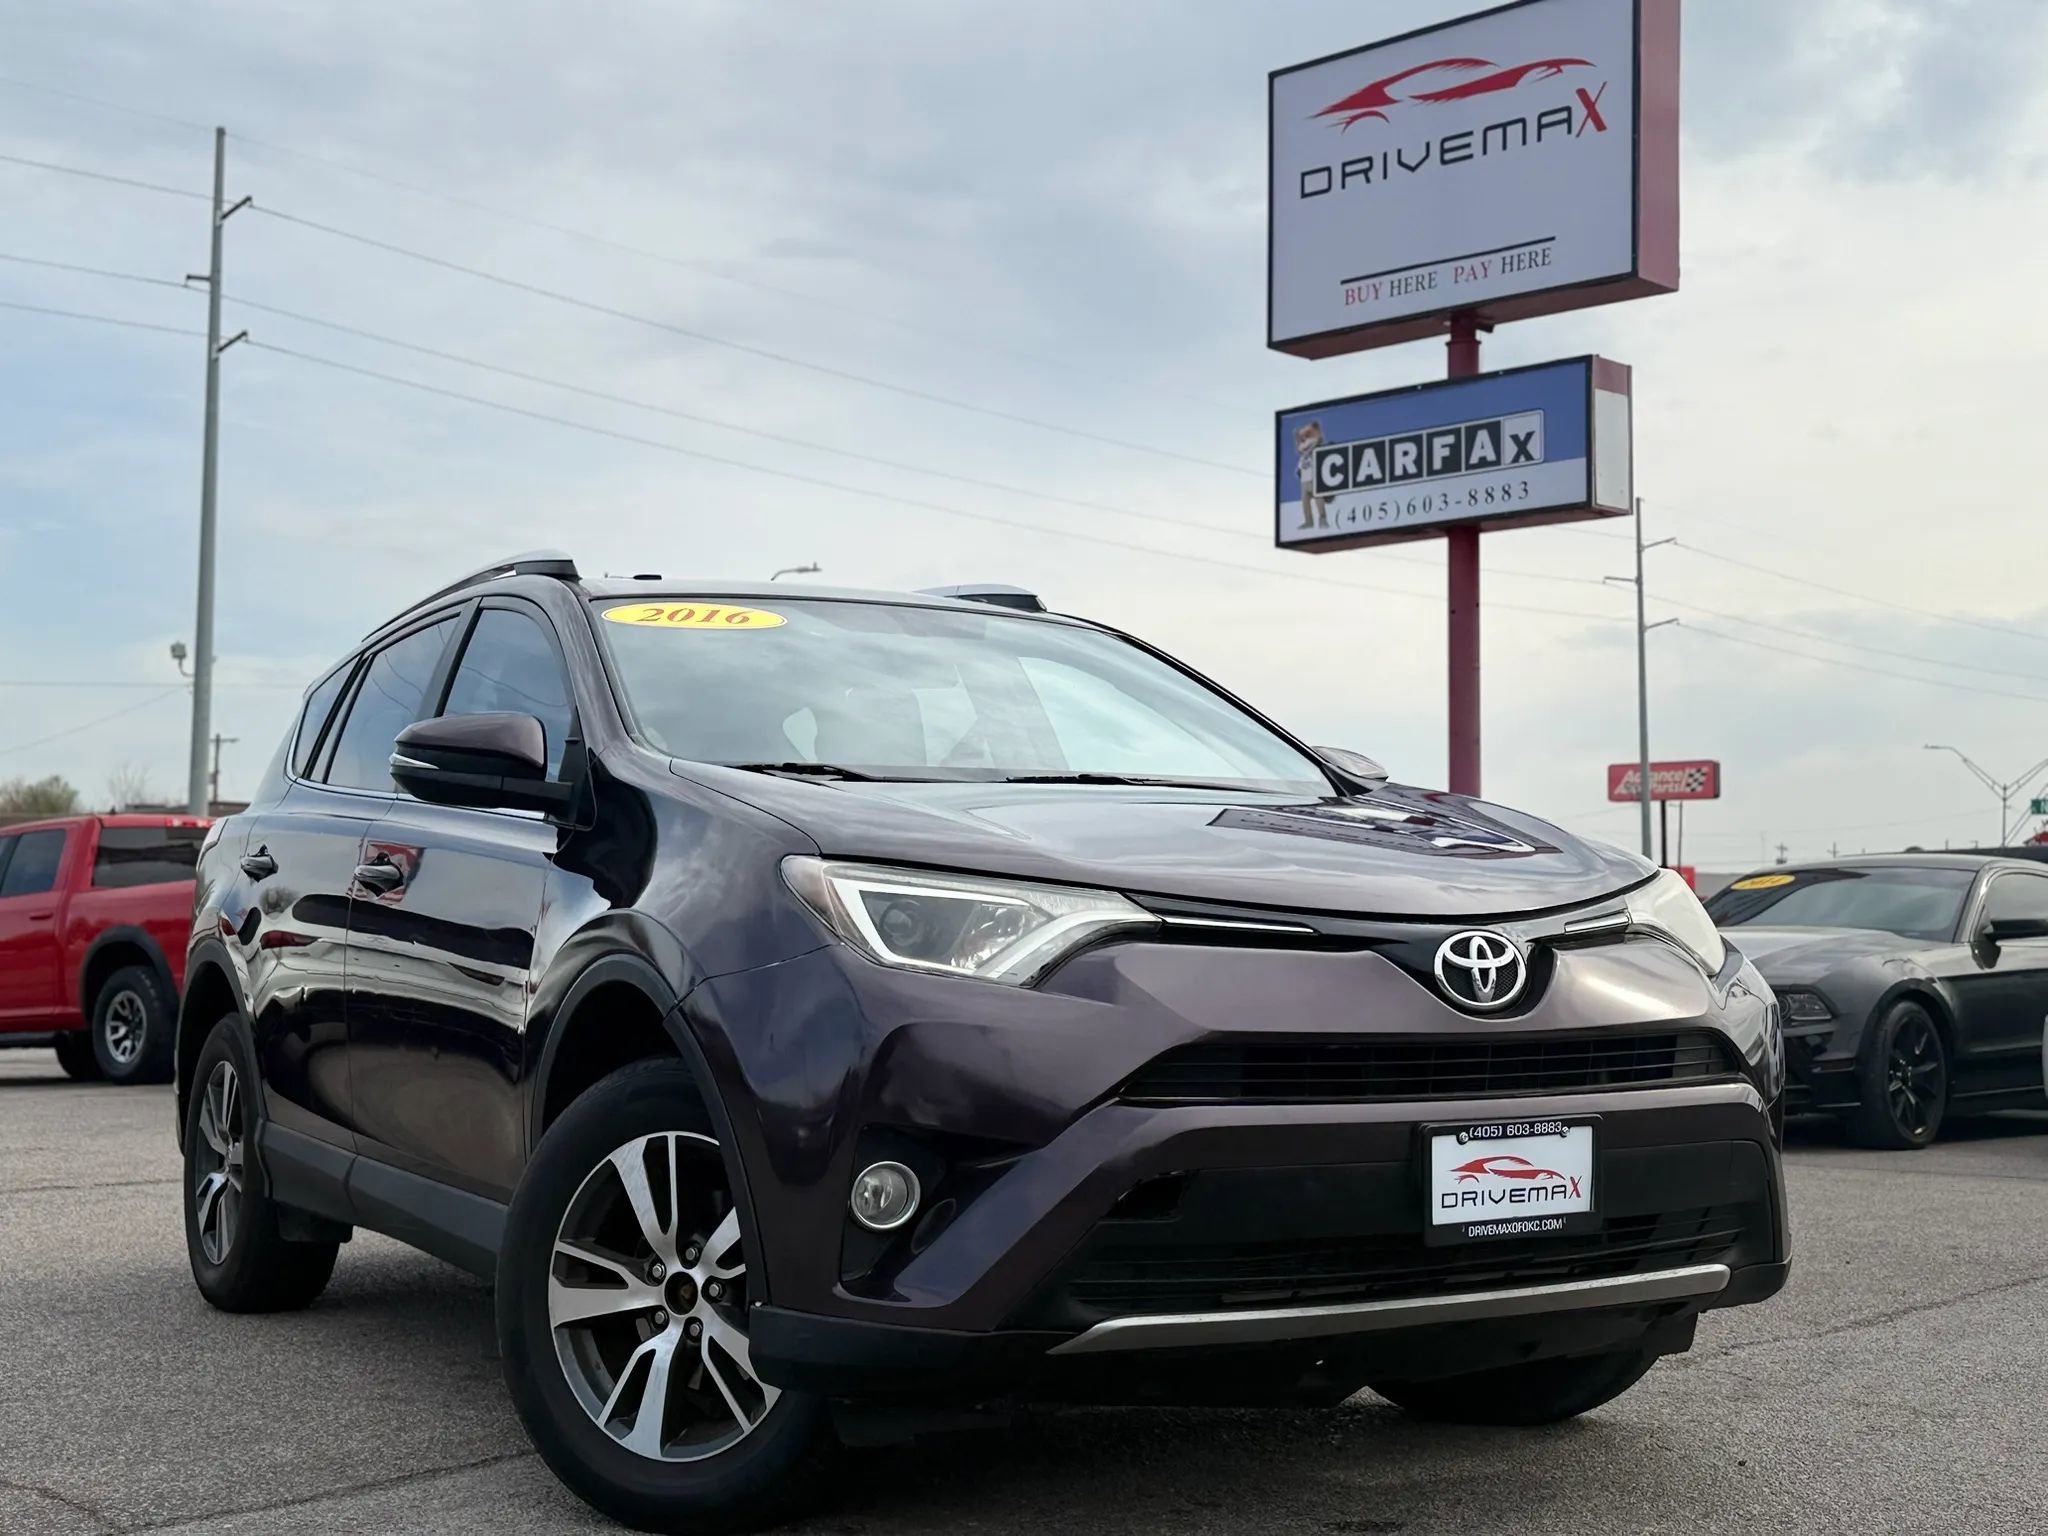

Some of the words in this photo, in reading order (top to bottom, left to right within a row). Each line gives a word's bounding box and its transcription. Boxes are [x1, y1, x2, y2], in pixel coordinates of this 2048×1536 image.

[1300, 81, 1608, 199] DRIVEMAX
[1344, 282, 1384, 306] BUY
[1389, 271, 1438, 298] HERE
[1453, 259, 1493, 285] PAY
[1500, 247, 1552, 275] HERE
[1320, 429, 1535, 487] CARFAX
[1335, 480, 1530, 529] (405)603-8883
[636, 608, 755, 625] 2016
[1469, 1126, 1503, 1138] (405)
[1507, 1121, 1562, 1136] 603-8883
[1441, 1176, 1582, 1208] DRIVEMAX
[1468, 1218, 1562, 1237] DRIVEMAXOFOKC.COM
